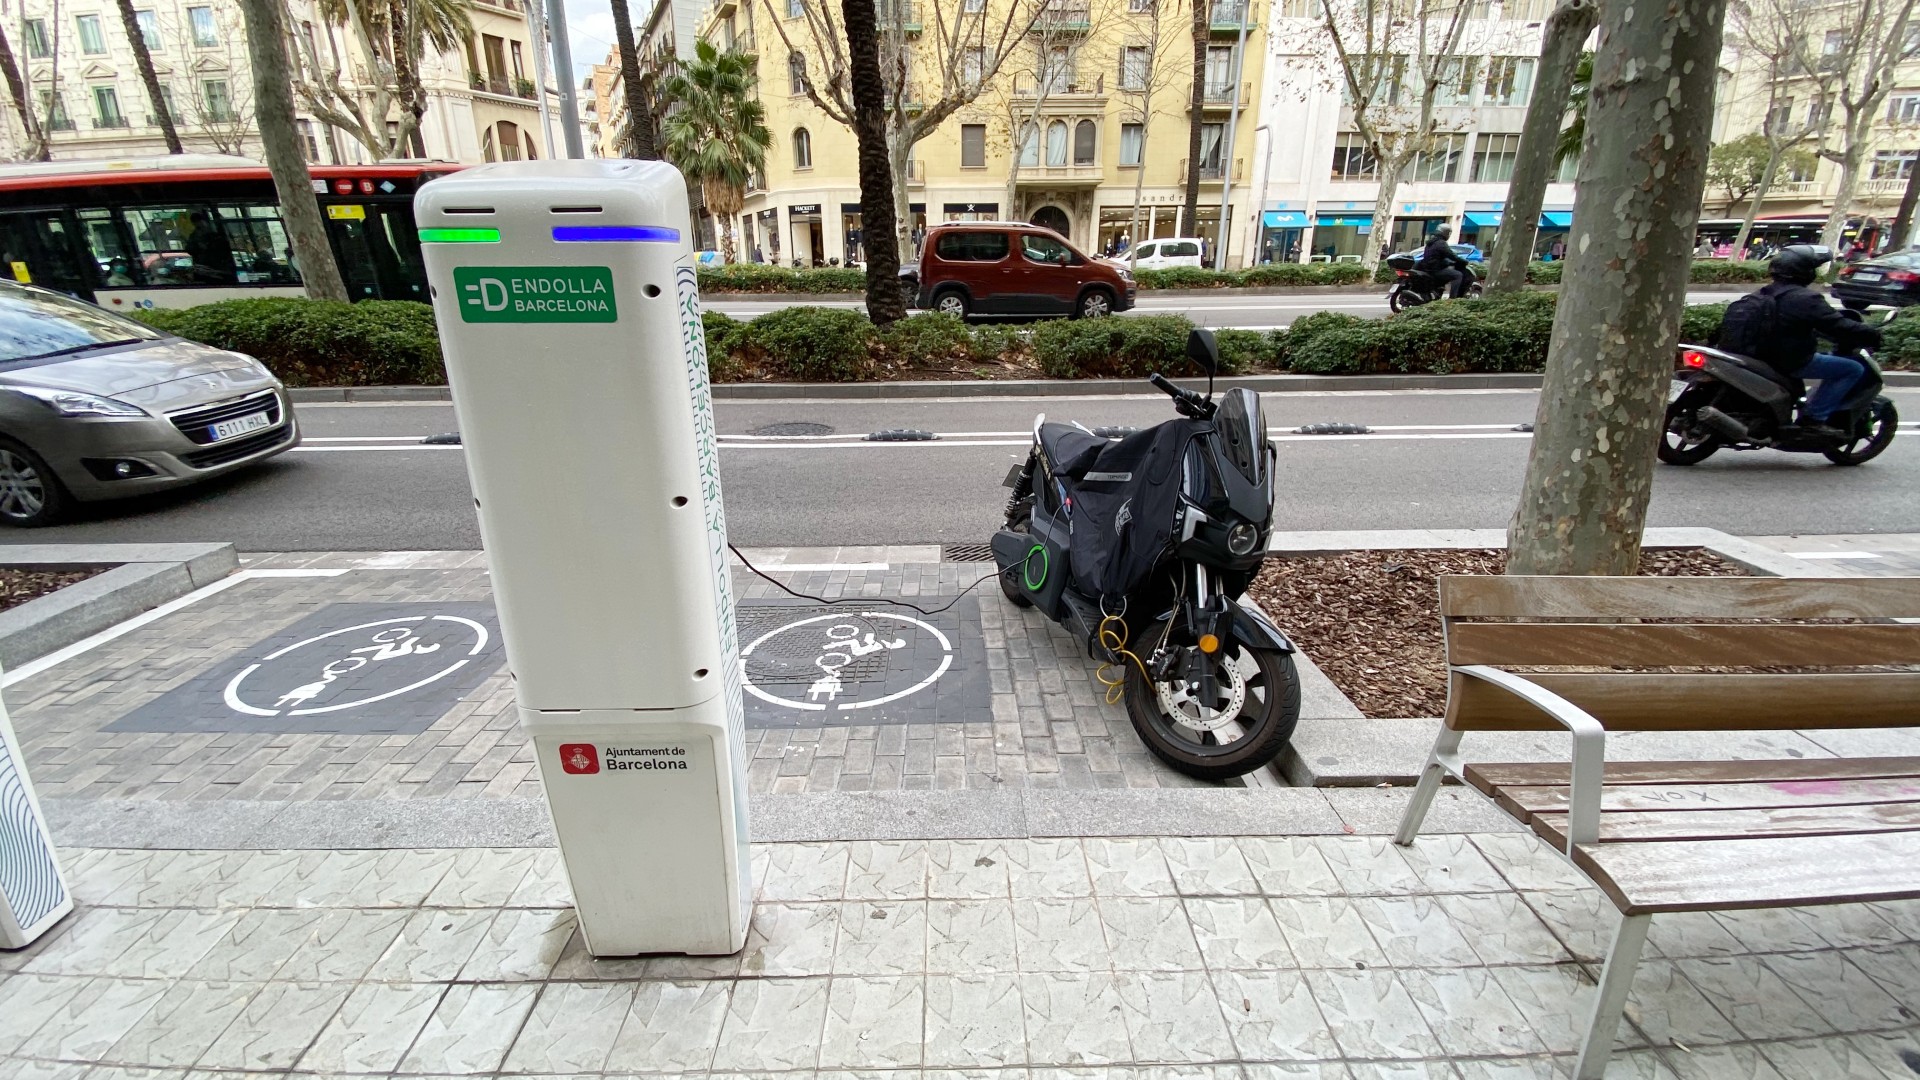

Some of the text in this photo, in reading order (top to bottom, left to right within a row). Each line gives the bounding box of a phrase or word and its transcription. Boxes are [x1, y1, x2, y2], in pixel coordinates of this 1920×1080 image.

[1142, 194, 1183, 202] sandr
[511, 278, 606, 294] ENDOLLA
[514, 299, 609, 312] BARCELONA
[218, 415, 267, 437] 6111 HXL
[686, 293, 732, 653] ENDOLLA BARCELONA
[606, 747, 686, 758] Ajuntament de
[606, 758, 688, 771] Barcelona
